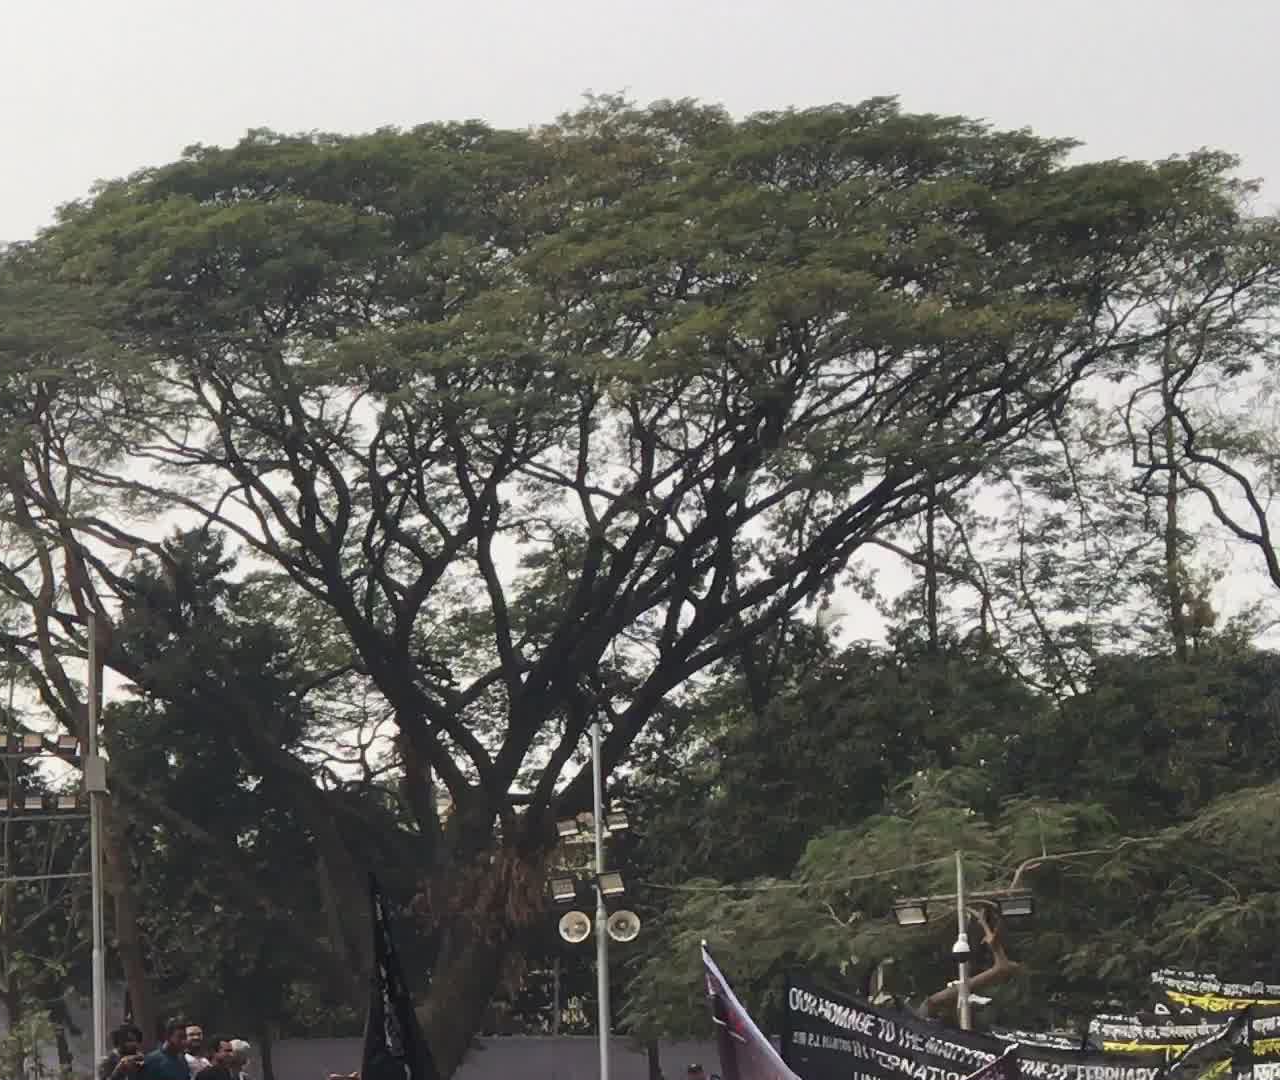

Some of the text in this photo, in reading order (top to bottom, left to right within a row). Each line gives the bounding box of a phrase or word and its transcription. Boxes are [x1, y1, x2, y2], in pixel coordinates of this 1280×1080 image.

[788, 987, 819, 1017] OUR
[817, 998, 876, 1037] HOMAGE
[877, 1017, 897, 1043] TO
[898, 1027, 925, 1053] THE
